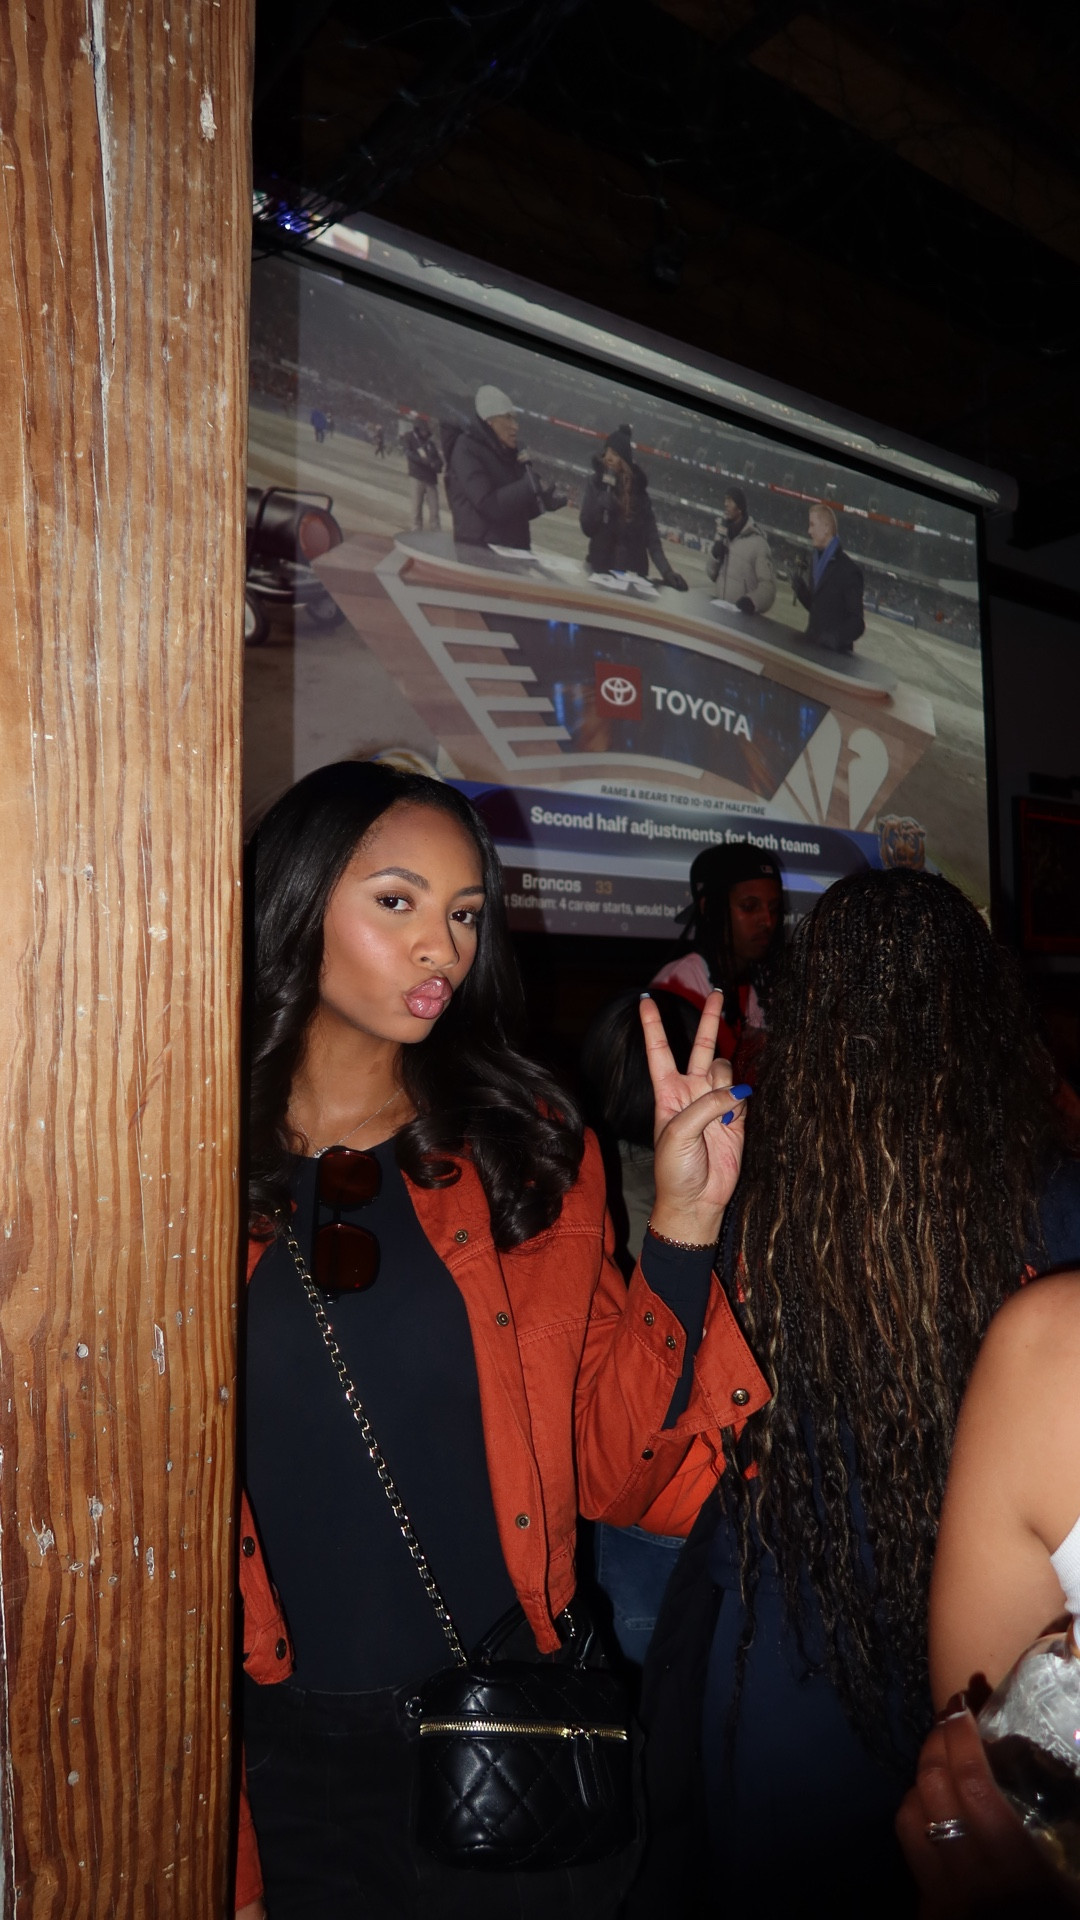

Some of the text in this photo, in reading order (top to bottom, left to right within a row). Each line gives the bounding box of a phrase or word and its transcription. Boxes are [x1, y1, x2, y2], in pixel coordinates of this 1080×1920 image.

[650, 685, 752, 742] TOYOTA
[601, 785, 766, 815] RAMS & BEARS TIED 10-10 AT HALFTIME
[530, 805, 820, 855] Second half adjustments for both teams
[522, 873, 613, 895] Broncos 33
[559, 899, 567, 910] 4
[568, 901, 600, 913] career
[602, 901, 634, 917] starts,
[635, 904, 662, 917] would
[664, 905, 675, 917] be
